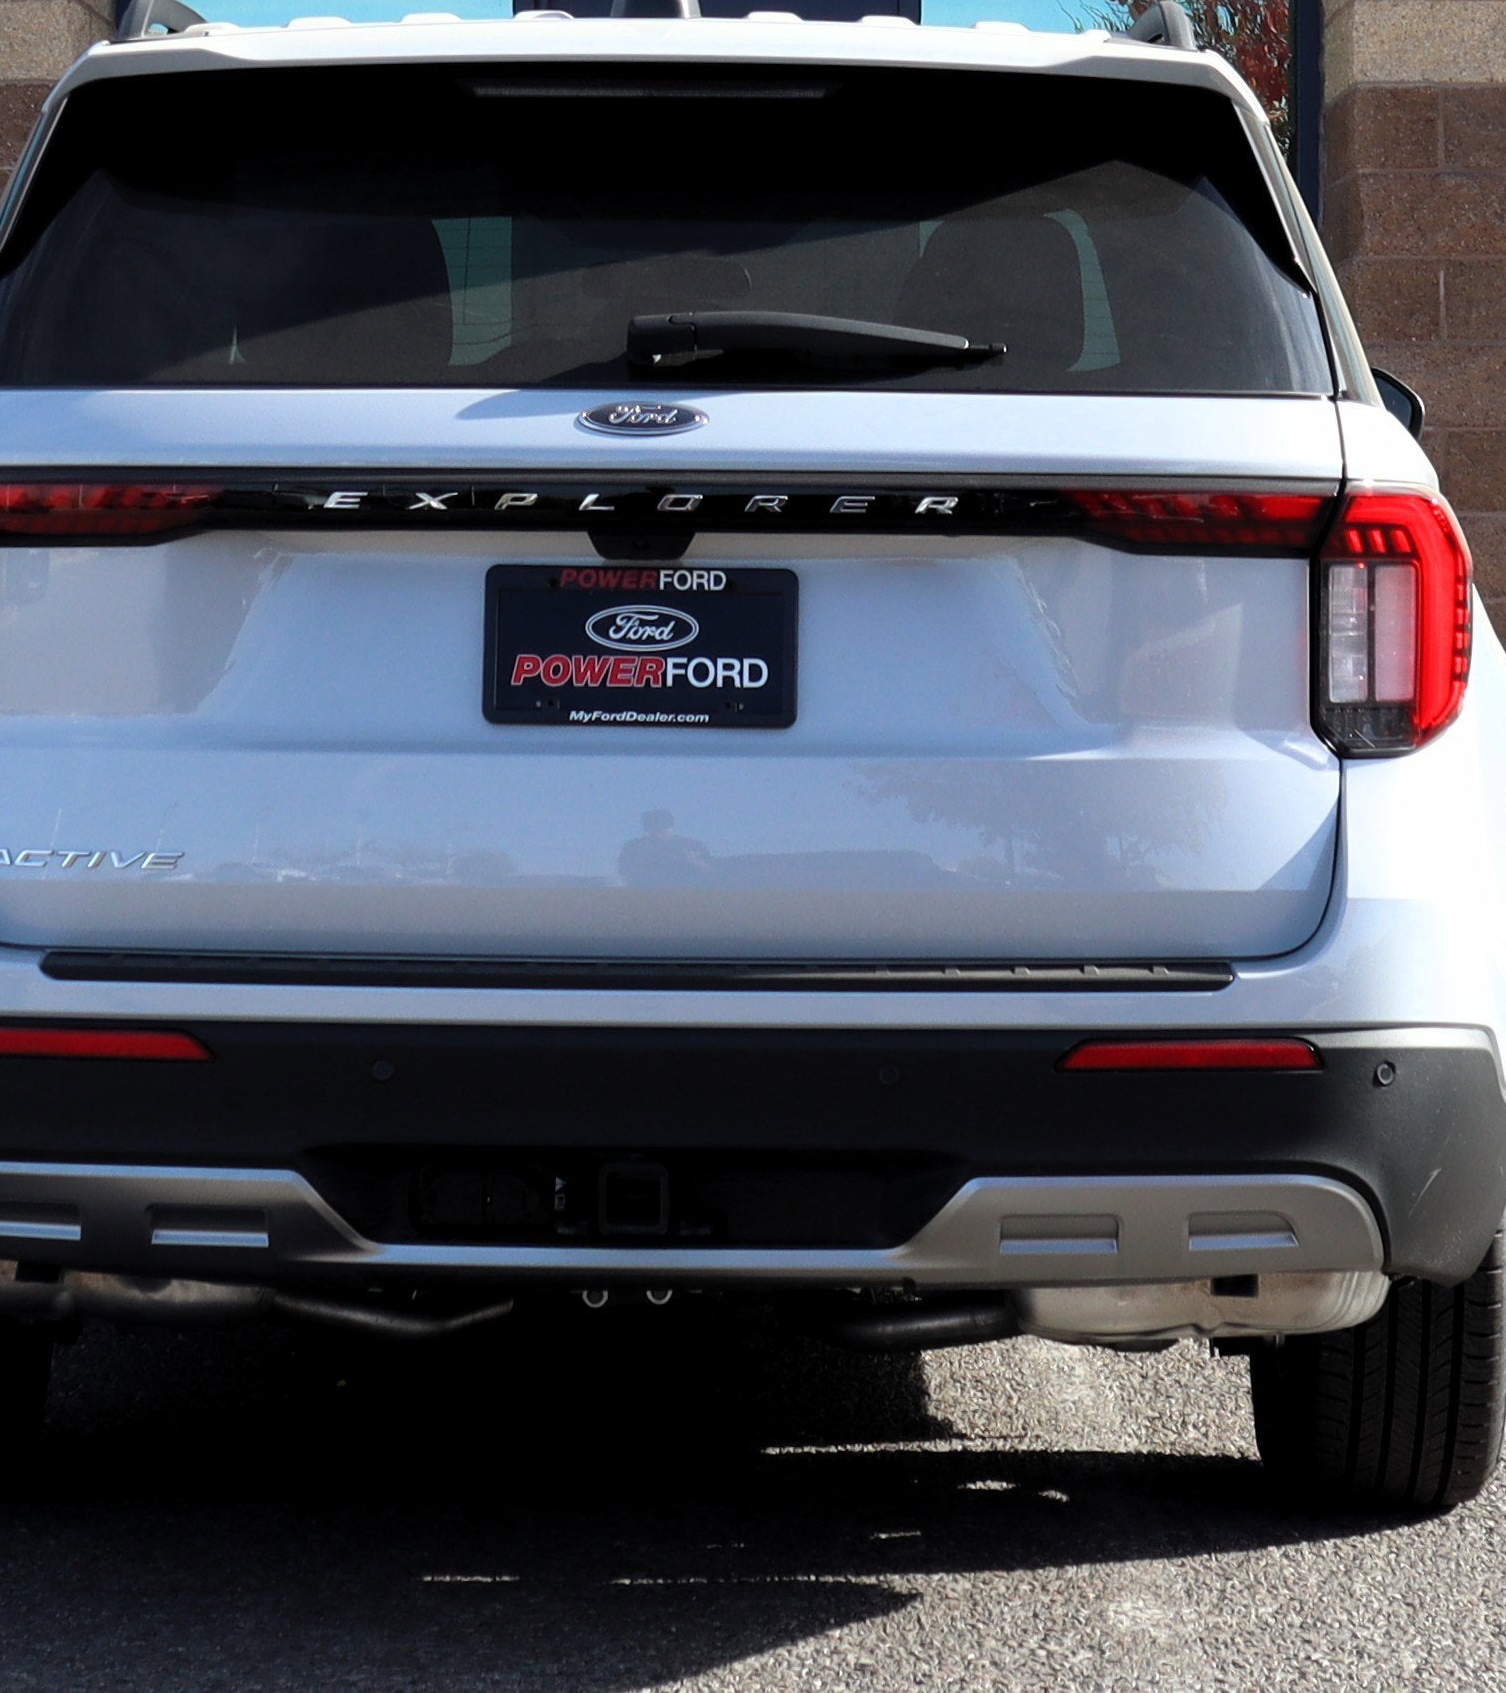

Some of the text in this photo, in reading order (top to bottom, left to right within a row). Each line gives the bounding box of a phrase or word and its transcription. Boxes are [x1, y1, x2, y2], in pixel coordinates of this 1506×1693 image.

[608, 404, 678, 424] Ford
[322, 491, 960, 515] EXPLORER
[608, 611, 676, 641] Ford
[568, 710, 710, 725] MyFordDealer.com
